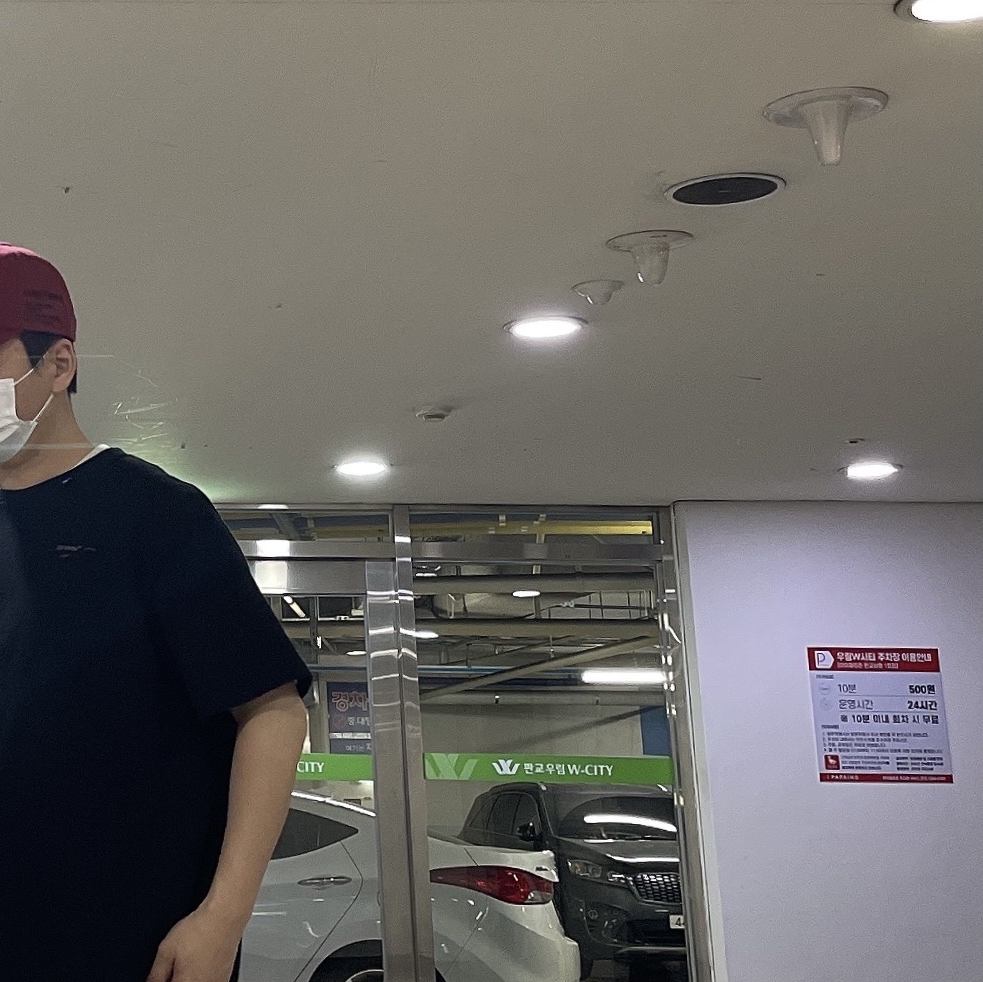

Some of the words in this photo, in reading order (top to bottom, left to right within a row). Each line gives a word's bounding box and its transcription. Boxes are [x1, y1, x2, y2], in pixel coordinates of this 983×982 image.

[878, 653, 901, 662] 주차장
[838, 684, 857, 694] 10분
[909, 684, 936, 695] 500원
[838, 699, 874, 710] 운영시간
[907, 700, 938, 711] 24시간
[852, 714, 870, 724] 10분
[873, 714, 890, 724] 이내
[912, 715, 920, 724] 시
[922, 715, 939, 725] 무료
[523, 762, 566, 775] 판교우림
[567, 764, 614, 776] W-CITY
